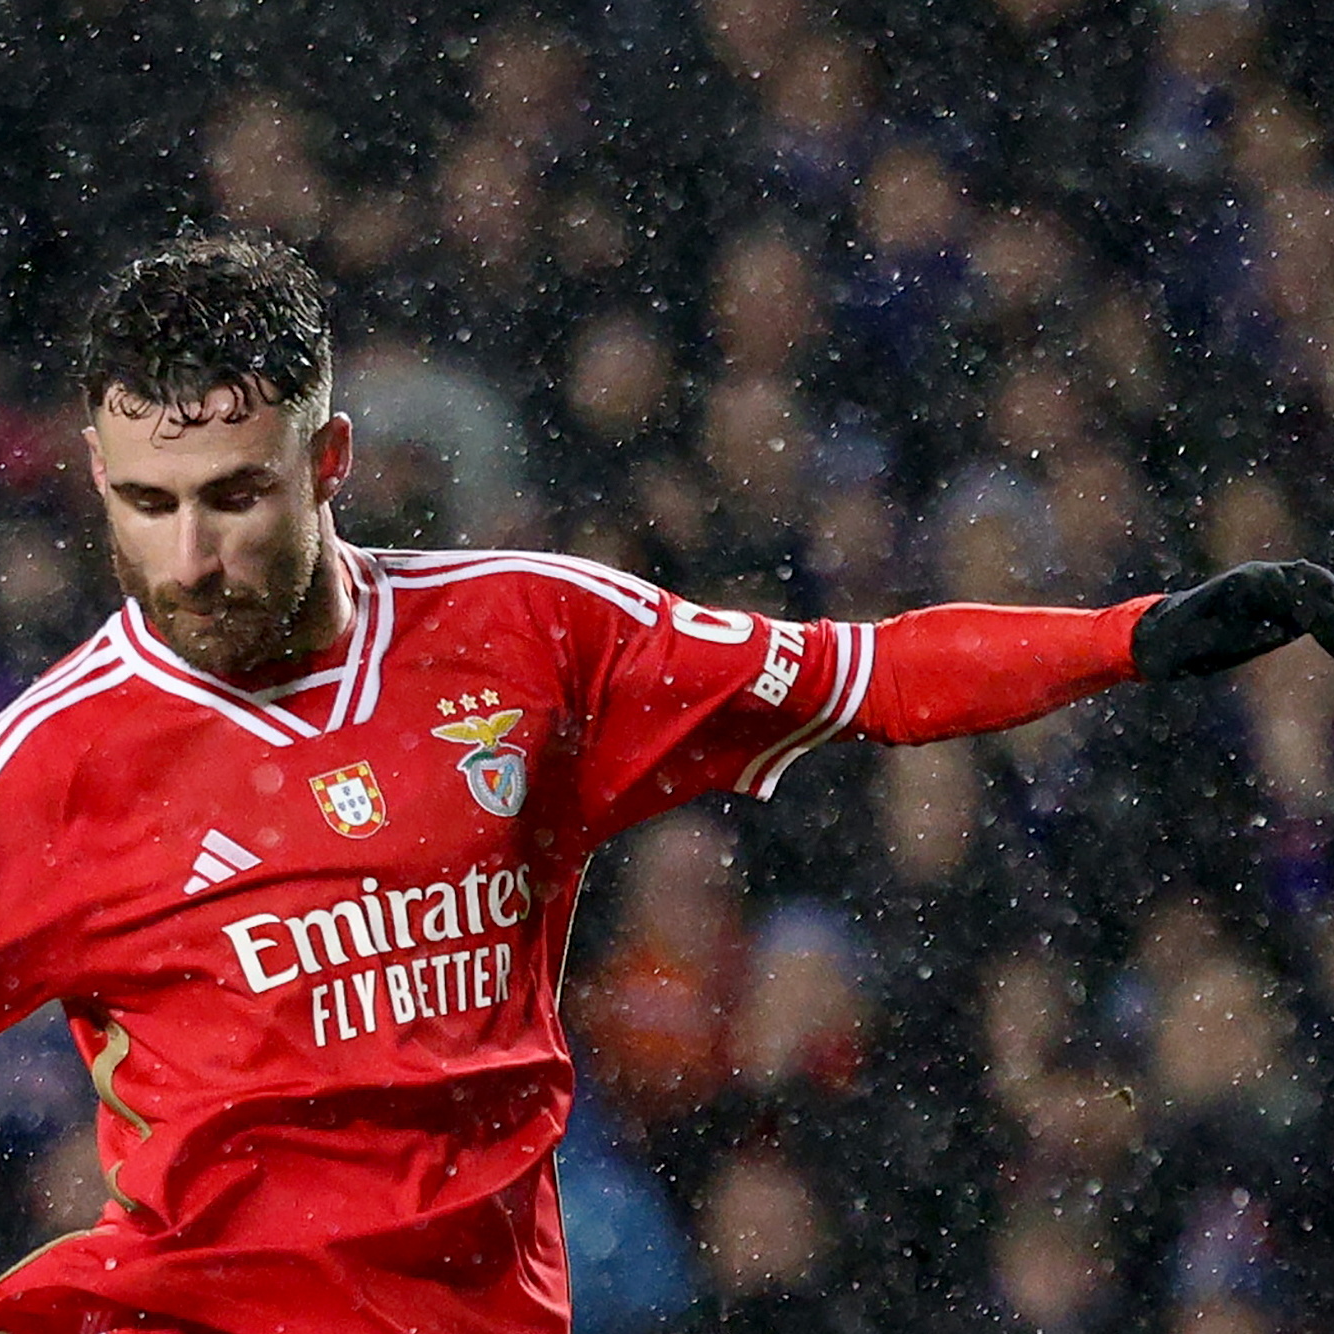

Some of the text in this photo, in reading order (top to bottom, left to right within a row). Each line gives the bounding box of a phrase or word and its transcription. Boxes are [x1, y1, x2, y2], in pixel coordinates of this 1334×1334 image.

[222, 863, 531, 994] Emirates
[312, 943, 511, 1047] FLY BETTER
